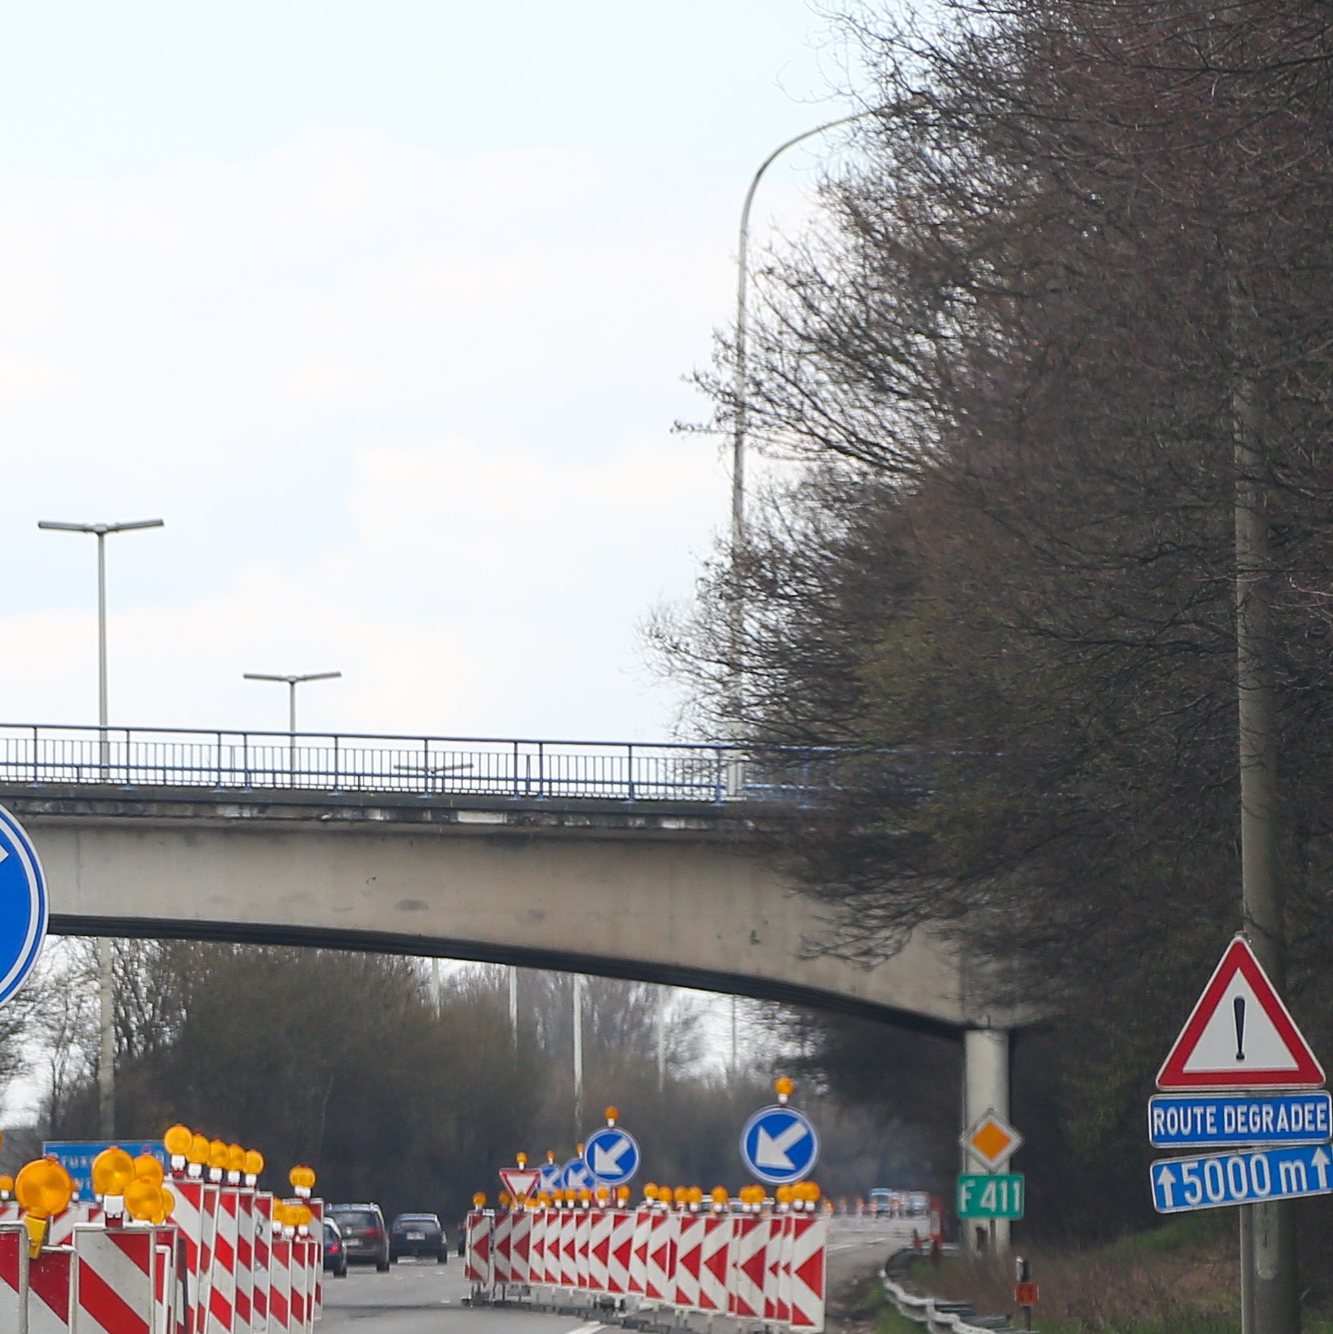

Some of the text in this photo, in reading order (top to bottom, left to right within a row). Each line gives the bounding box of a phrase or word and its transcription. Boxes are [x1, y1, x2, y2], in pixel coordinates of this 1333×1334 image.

[1154, 1102, 1328, 1136] ROUTE DEGRADEE
[961, 1180, 1020, 1212] F 411
[1181, 1153, 1307, 1206] 5000 m
